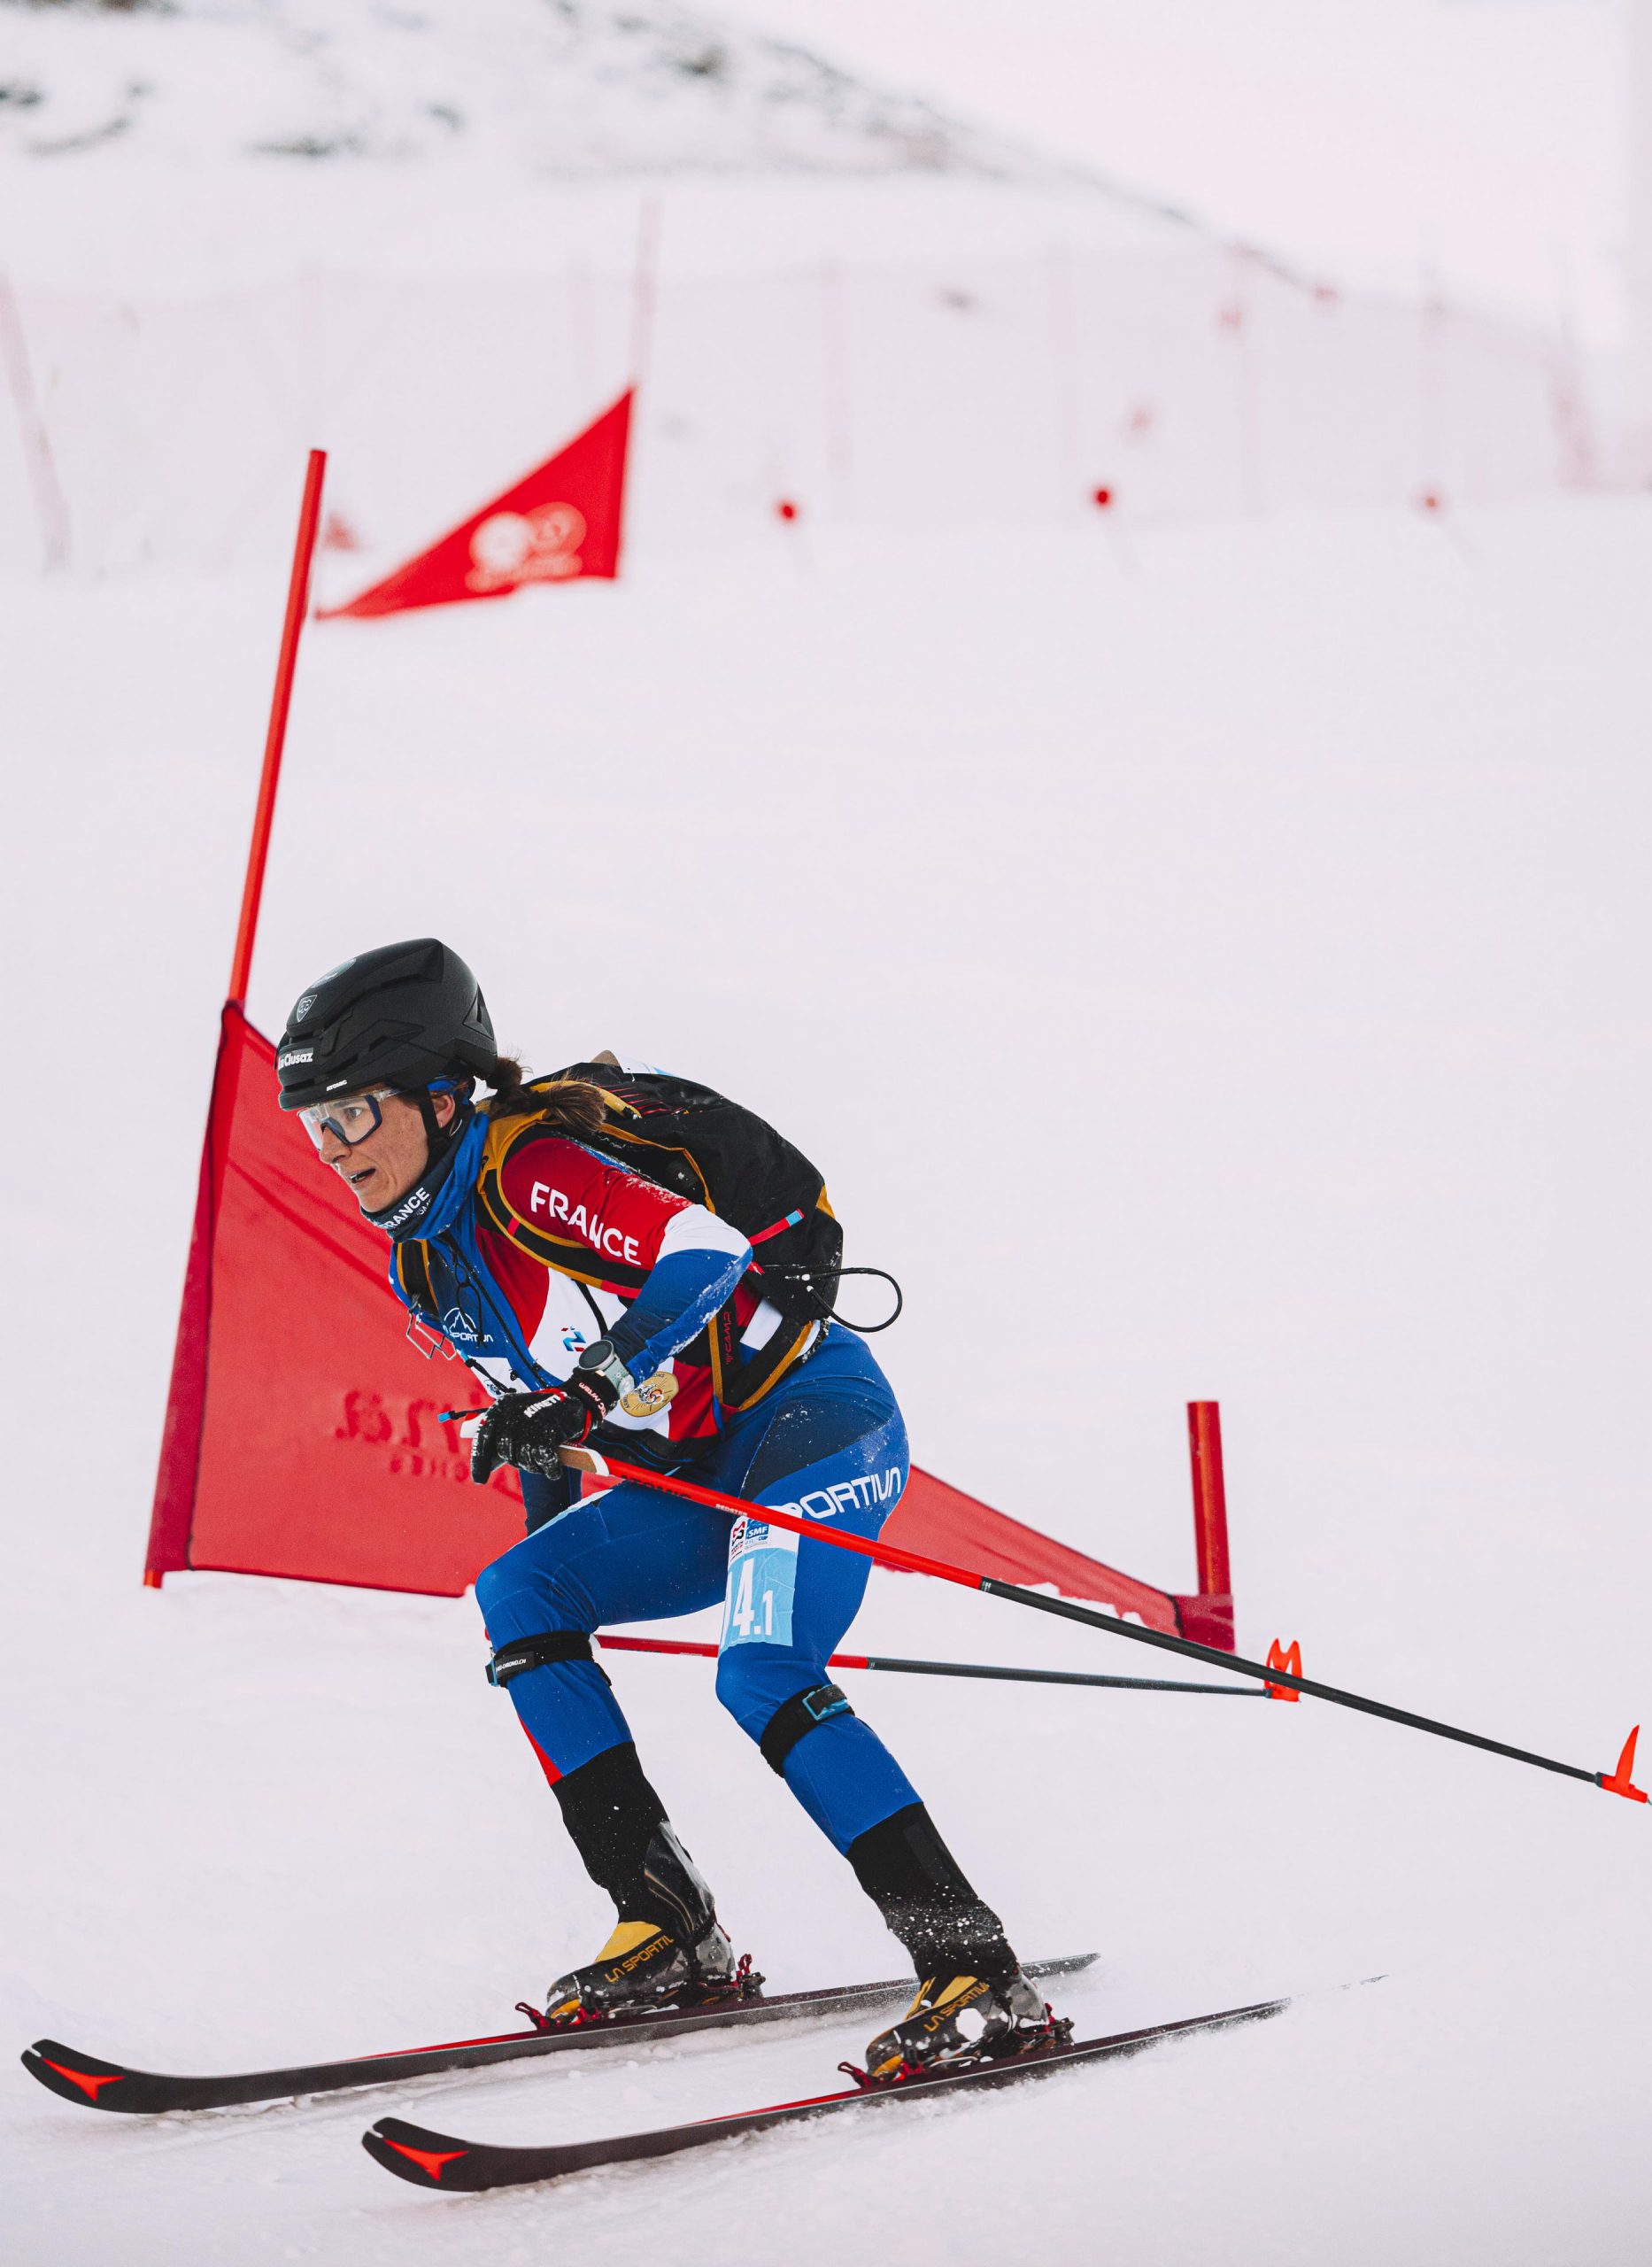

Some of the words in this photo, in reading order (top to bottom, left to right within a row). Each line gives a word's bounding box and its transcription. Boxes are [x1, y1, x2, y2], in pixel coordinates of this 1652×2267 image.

[284, 1052, 313, 1066] Clusaz
[326, 1079, 348, 1092] ATOMIC
[382, 1187, 430, 1229] RANCE
[531, 1180, 642, 1265] FRANCE
[605, 1968, 625, 1983] LA
[923, 2015, 945, 2032] LA
